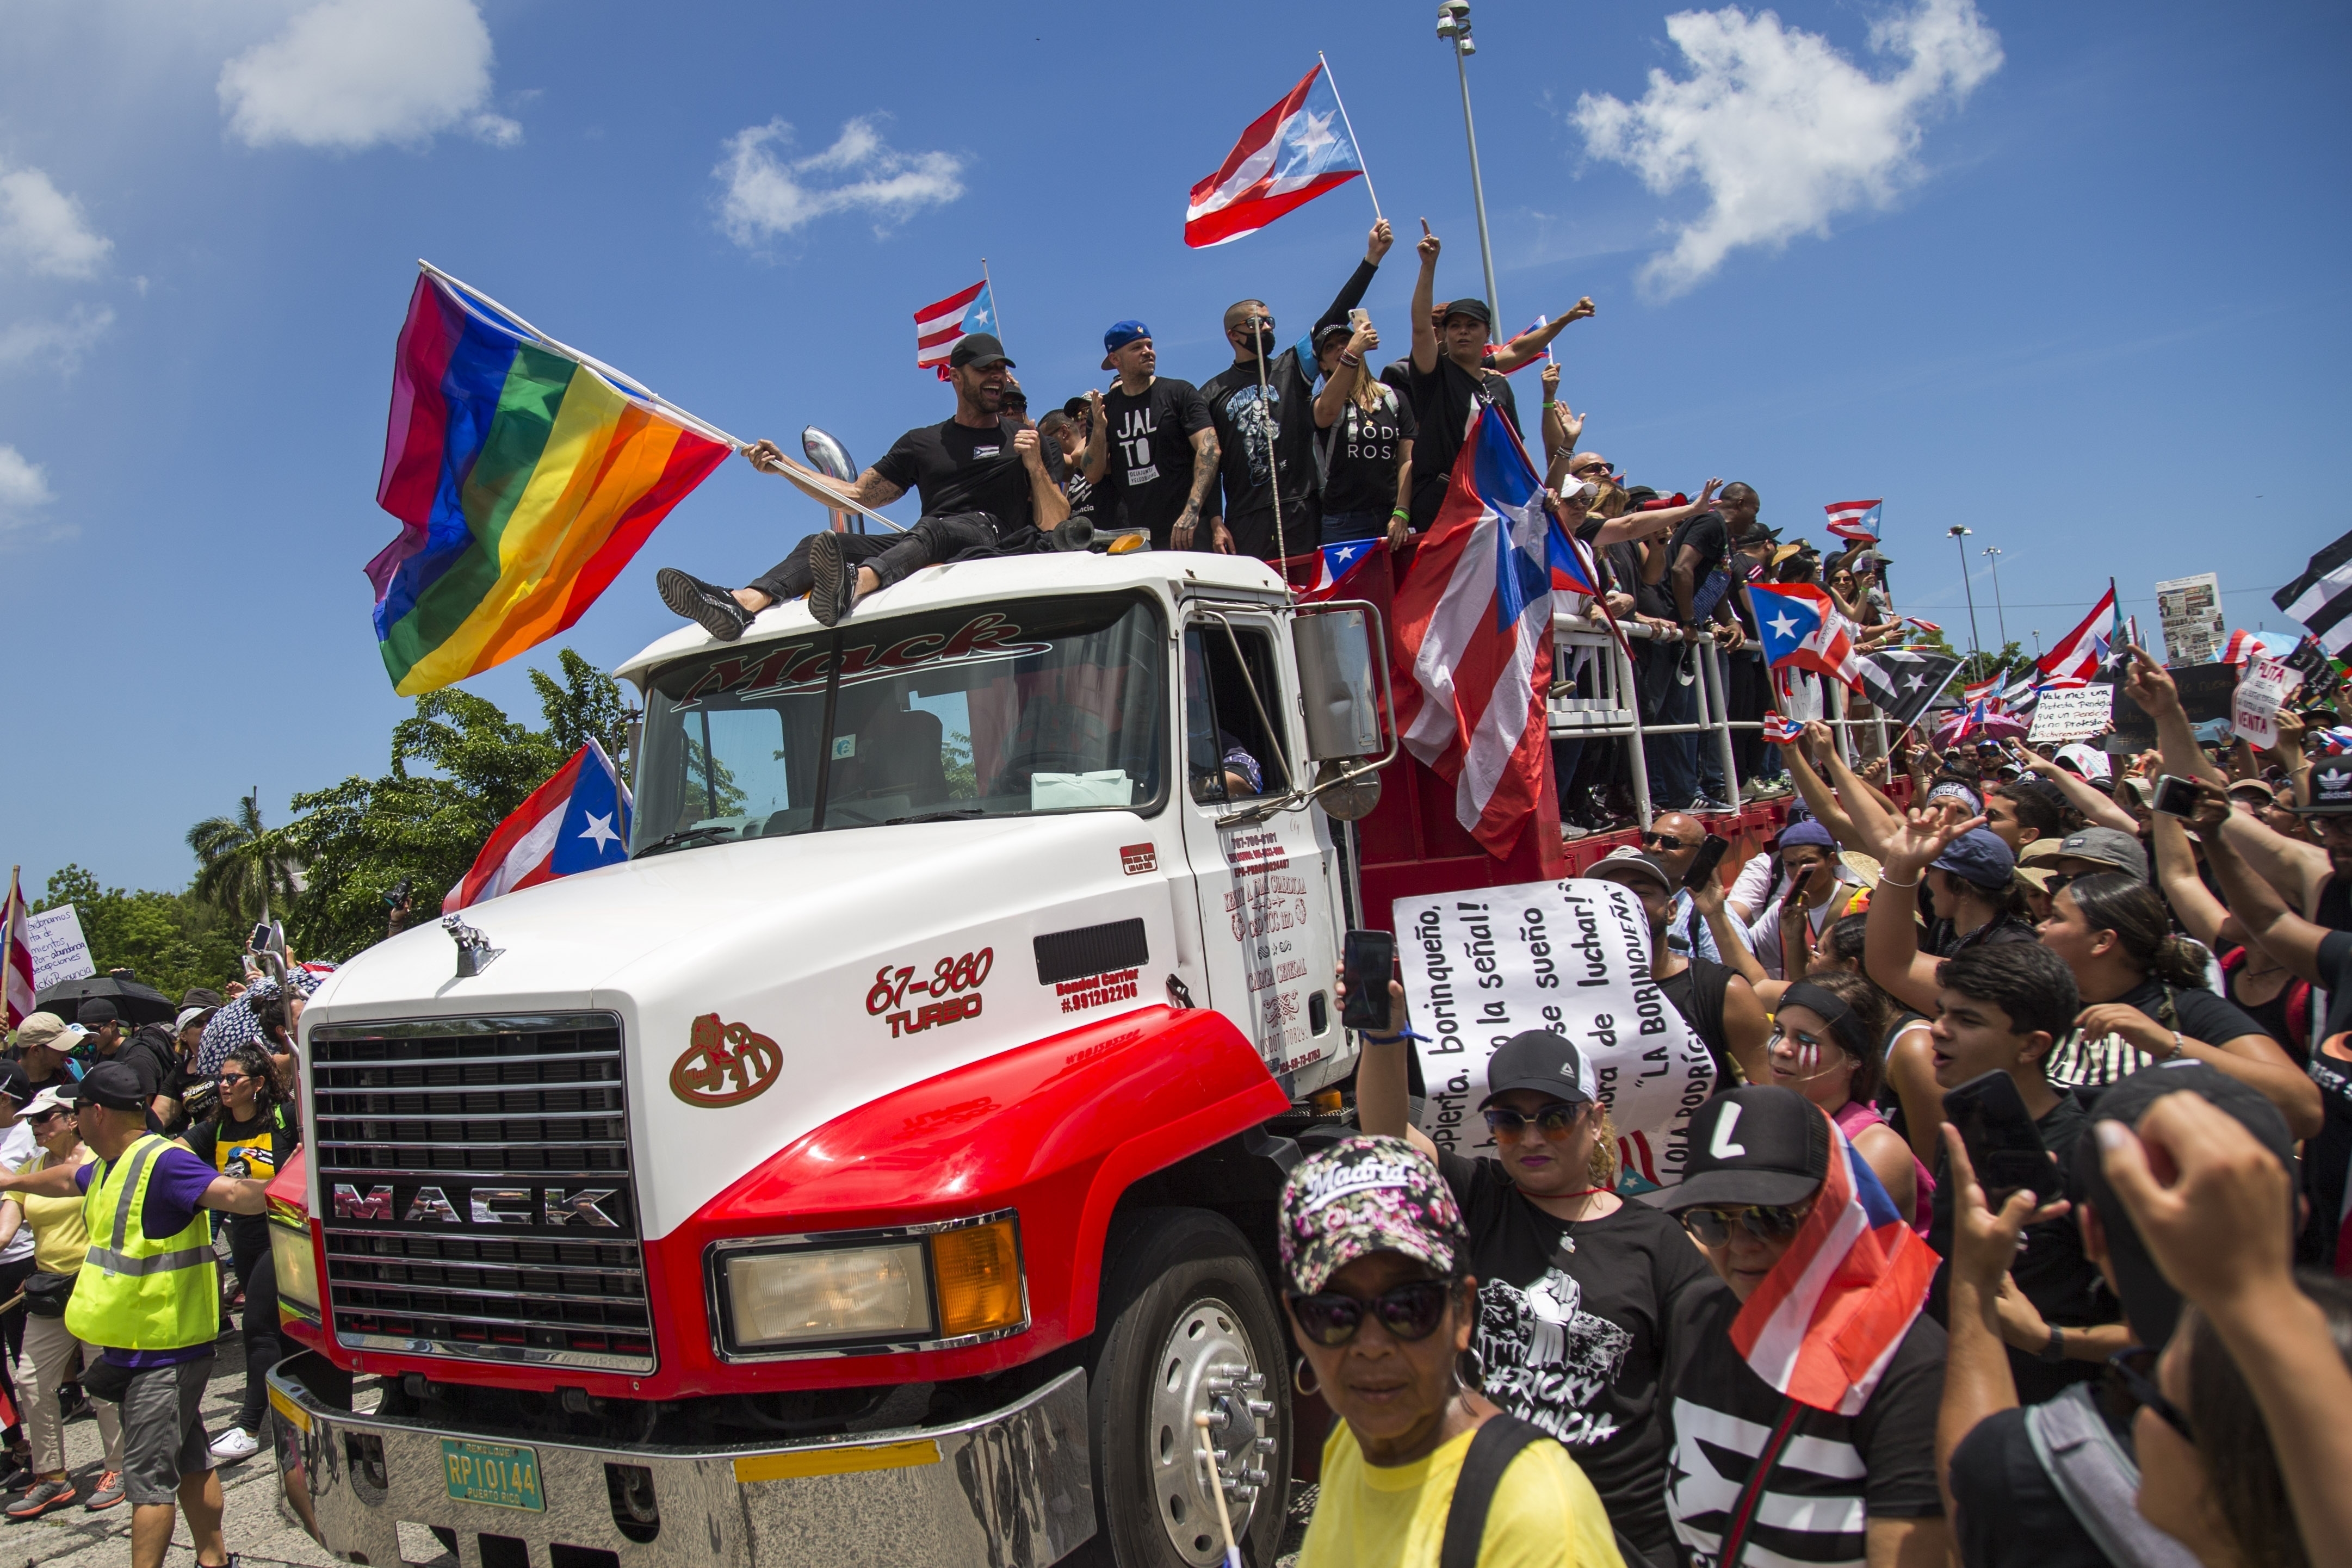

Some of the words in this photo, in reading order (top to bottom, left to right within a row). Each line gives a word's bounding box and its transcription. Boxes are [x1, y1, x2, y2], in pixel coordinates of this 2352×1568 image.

[1226, 385, 1258, 421] STONE
[1117, 408, 1157, 438] JAL
[1119, 438, 1150, 467] TO
[670, 613, 1053, 712] Mack
[2237, 710, 2267, 734] VENTA
[44, 926, 53, 937] de
[1457, 902, 1504, 989] señal!
[1519, 908, 1559, 989] sueño
[51, 941, 86, 959] abundancia
[866, 947, 993, 1016] E7-360
[1056, 975, 1100, 996] Bonded
[1101, 969, 1139, 986] Carrier
[1247, 968, 1276, 993] CARGA
[1276, 957, 1308, 983] GENERAL
[1414, 906, 1465, 1055] borinqueño,
[886, 993, 982, 1038] TURBO
[1476, 1001, 1511, 1025] la
[1587, 1014, 1618, 1047] de
[1260, 1033, 1280, 1057] USDOT
[1598, 1067, 1618, 1114] ora
[1710, 1101, 1746, 1159] L
[1303, 1156, 1416, 1203] Madrid
[334, 1184, 620, 1228] MACK
[1483, 1365, 1605, 1408] #RICKY
[466, 1444, 510, 1457] REMOLQUE
[448, 1454, 535, 1495] RP10144
[467, 1488, 498, 1501] PUERTO
[501, 1492, 520, 1504] RICO
